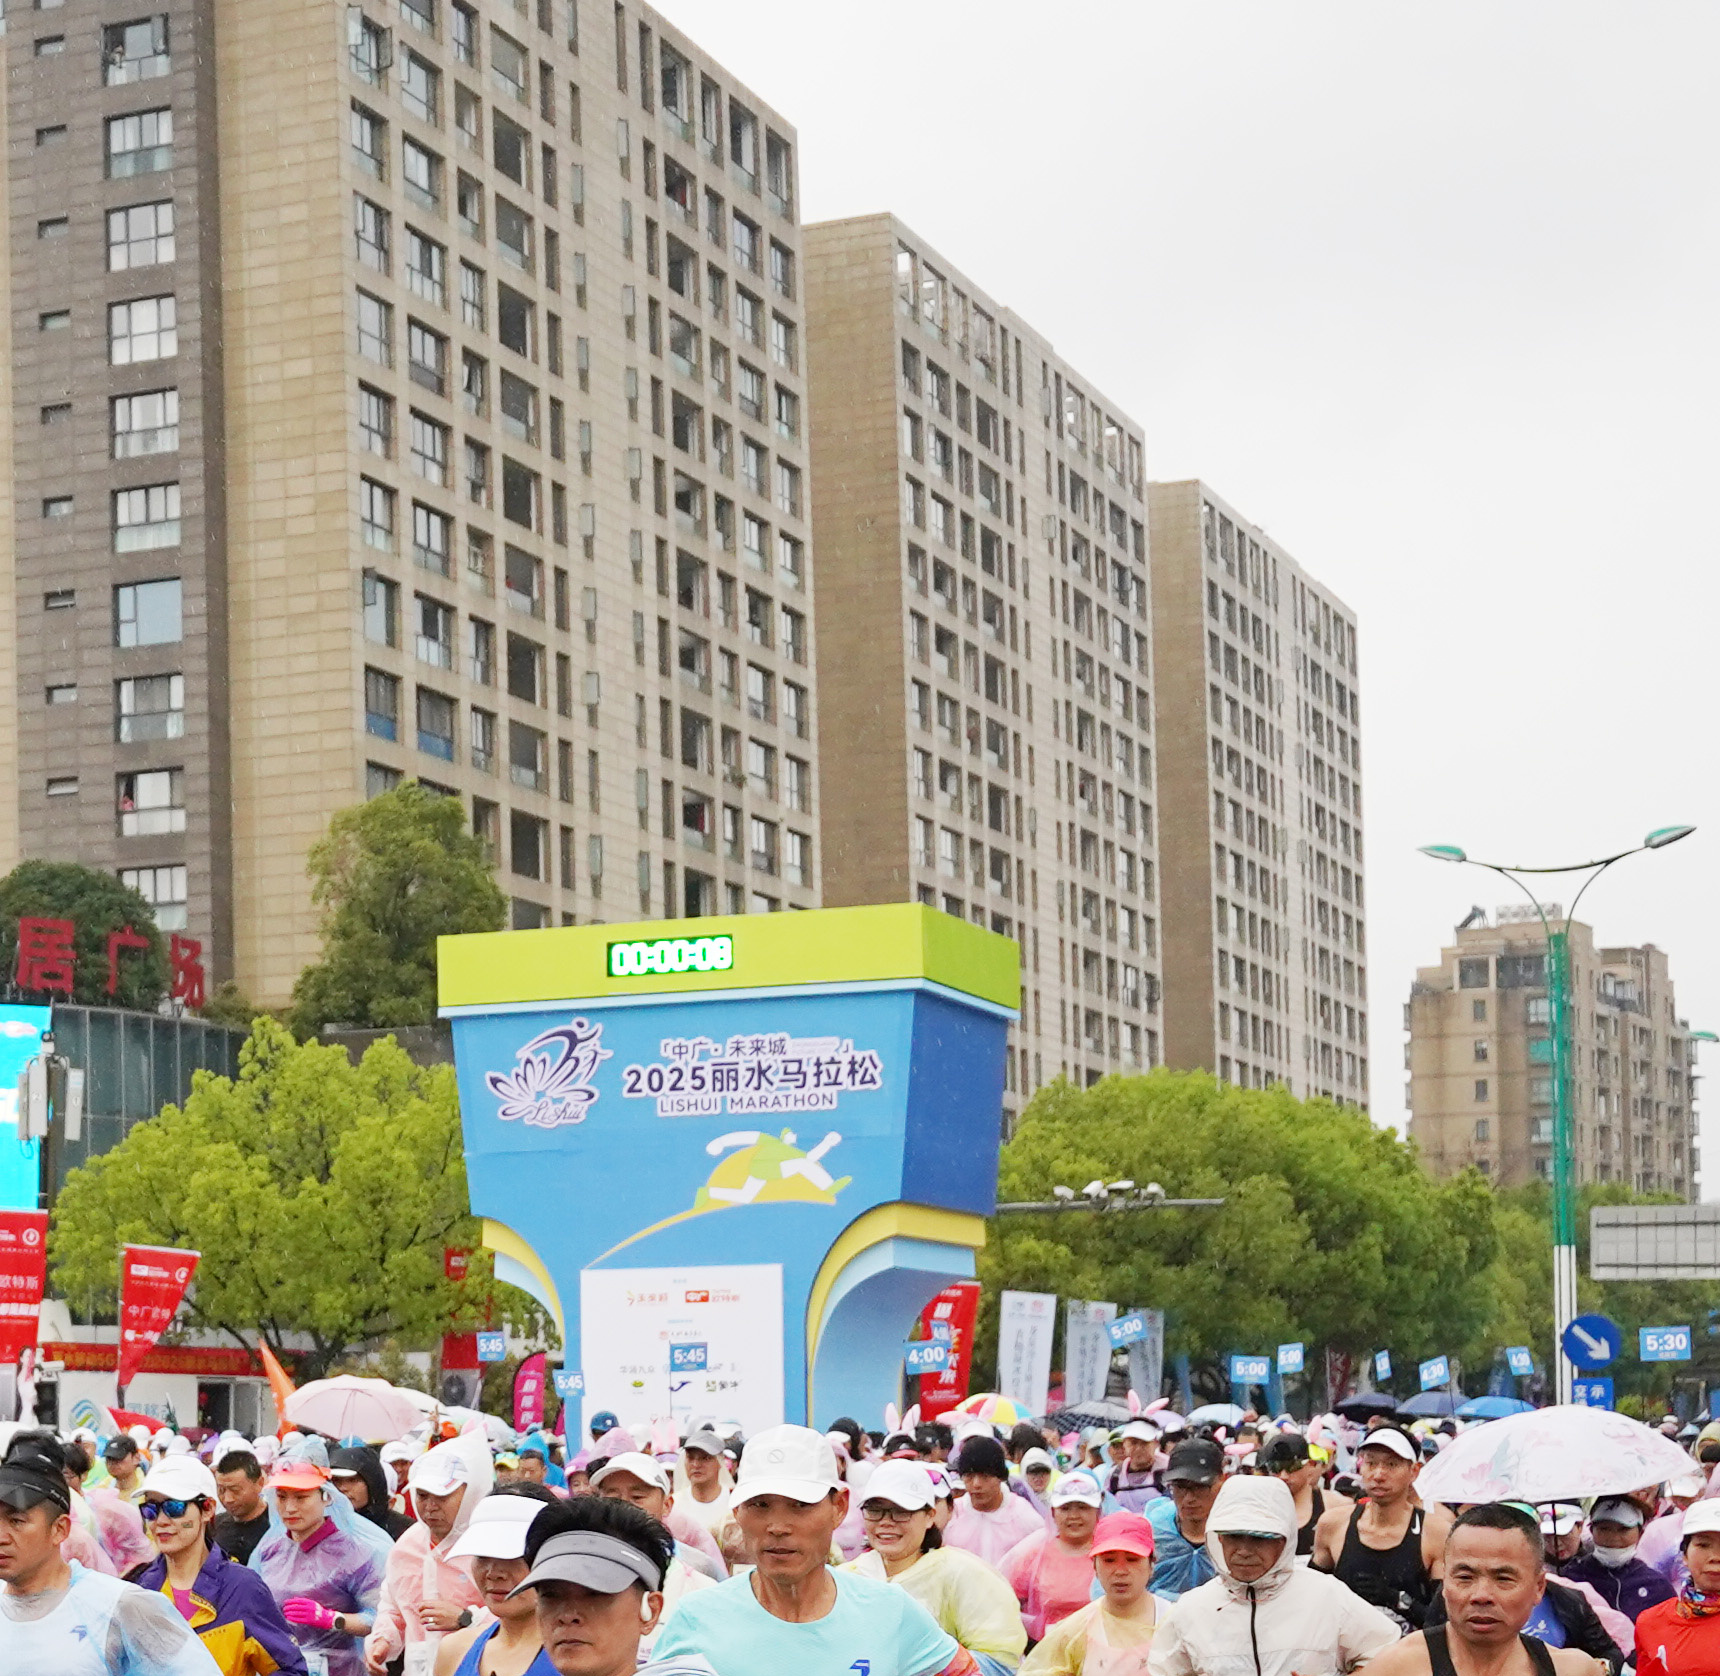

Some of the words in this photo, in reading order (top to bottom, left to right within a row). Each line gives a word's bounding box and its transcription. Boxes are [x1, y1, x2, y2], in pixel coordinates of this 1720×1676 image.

[611, 936, 732, 976] 00:00:08
[626, 1055, 879, 1096] 2025丽水马拉松
[661, 1096, 718, 1113] LISHUI
[729, 1092, 834, 1111] MARATHON
[1111, 1318, 1142, 1339] 5:00
[479, 1338, 502, 1352] 5:45
[1646, 1333, 1687, 1351] 5:30
[674, 1348, 705, 1364] 5:45
[908, 1346, 944, 1364] 4:00
[1280, 1349, 1301, 1365] 5:00
[1236, 1362, 1266, 1377] 5:00
[1422, 1365, 1444, 1381] 4:30
[557, 1375, 583, 1389] 5:45
